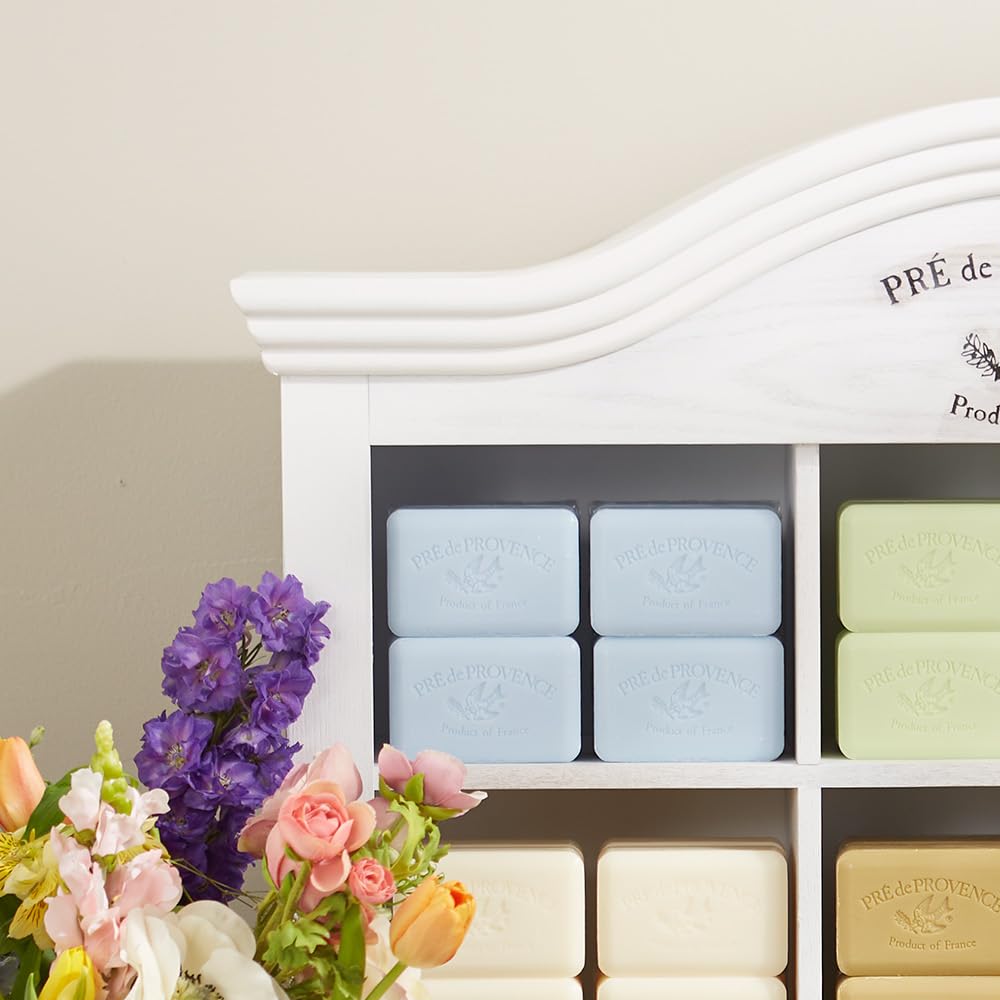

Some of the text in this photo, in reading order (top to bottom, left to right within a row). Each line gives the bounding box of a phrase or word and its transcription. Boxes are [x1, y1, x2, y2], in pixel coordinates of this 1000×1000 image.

[880, 252, 951, 305] PRÉ
[961, 253, 992, 282] de
[446, 537, 461, 555] de
[464, 536, 556, 572] PROVENCE
[649, 538, 664, 556] de
[667, 537, 759, 572] PROVENCE
[448, 665, 463, 683] de
[466, 664, 557, 699] PROVENCE
[652, 665, 667, 683] de
[670, 664, 760, 699] PROVENCE
[861, 887, 895, 910] PRÉ
[896, 879, 911, 896] de
[889, 936, 976, 950] Product of France
